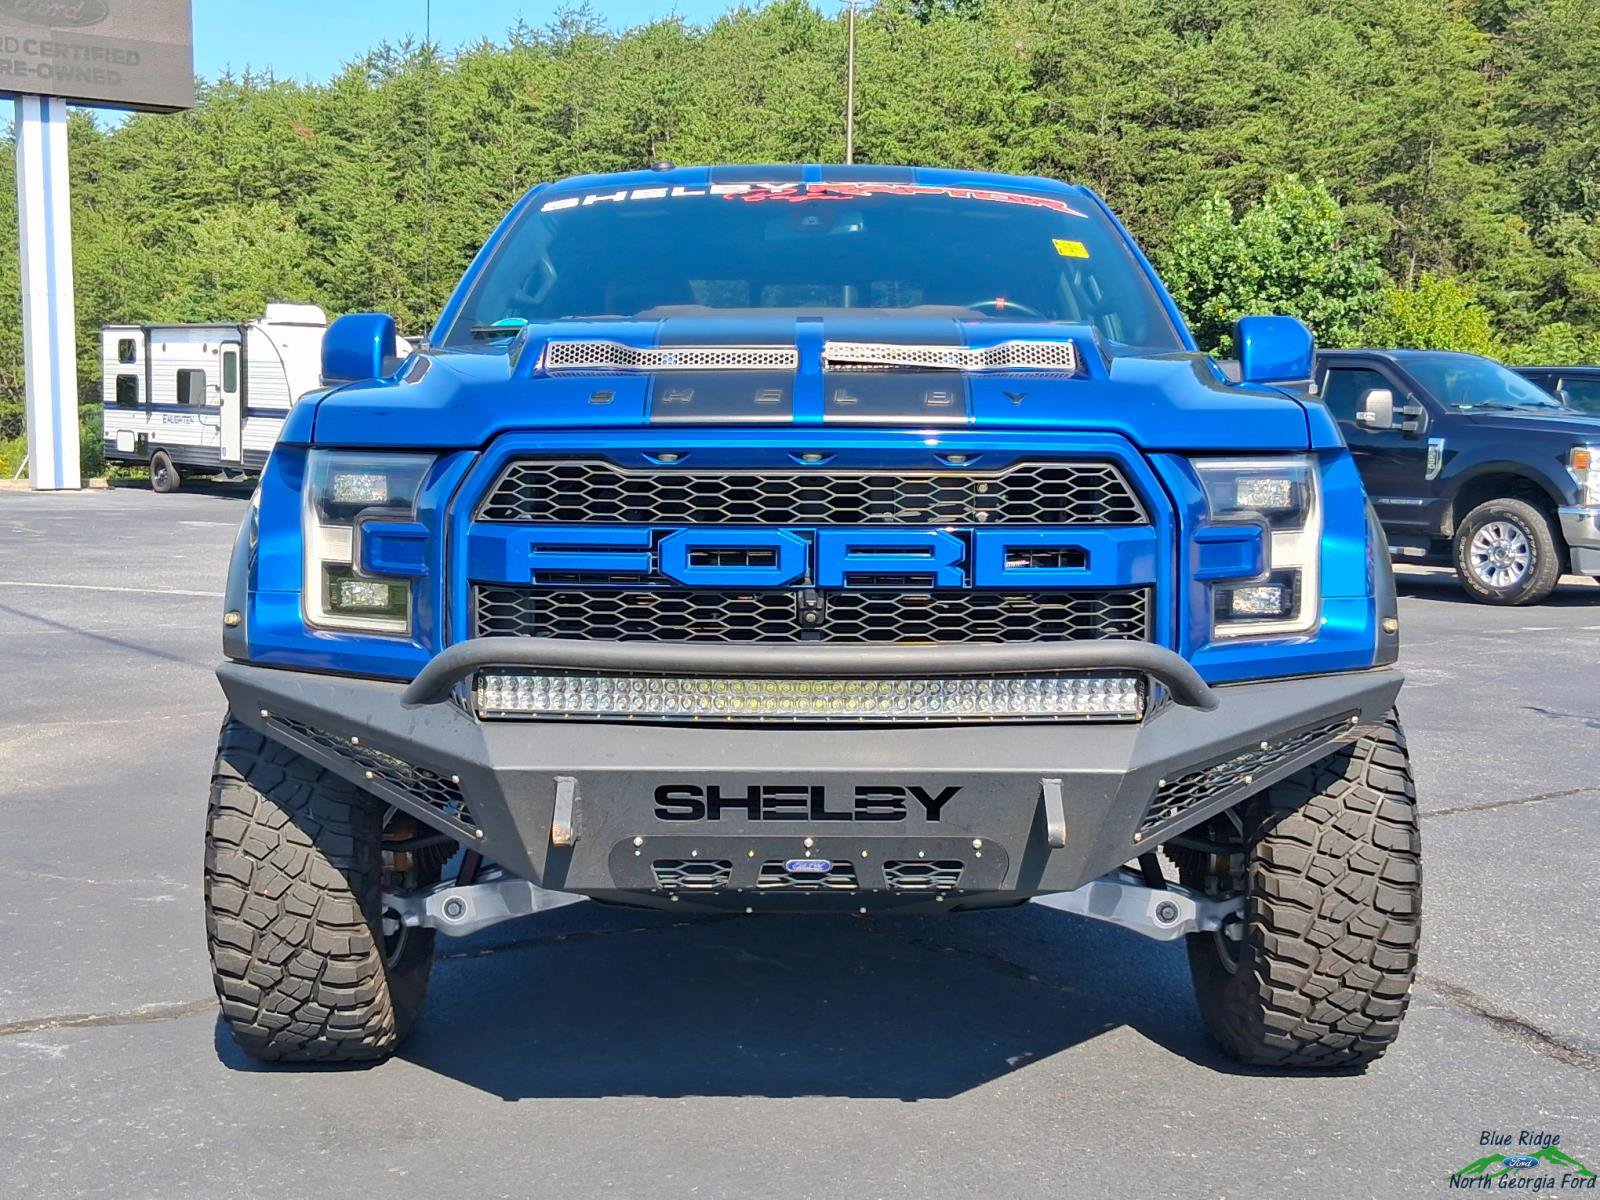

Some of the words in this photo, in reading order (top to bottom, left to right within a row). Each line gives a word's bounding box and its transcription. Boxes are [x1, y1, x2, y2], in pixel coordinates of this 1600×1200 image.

[23, 39, 141, 66] CERTIFIED
[541, 183, 799, 212] SHELBY
[588, 389, 1030, 406] SHELBY
[506, 527, 1118, 587] FORD
[654, 784, 964, 823] SHELBY
